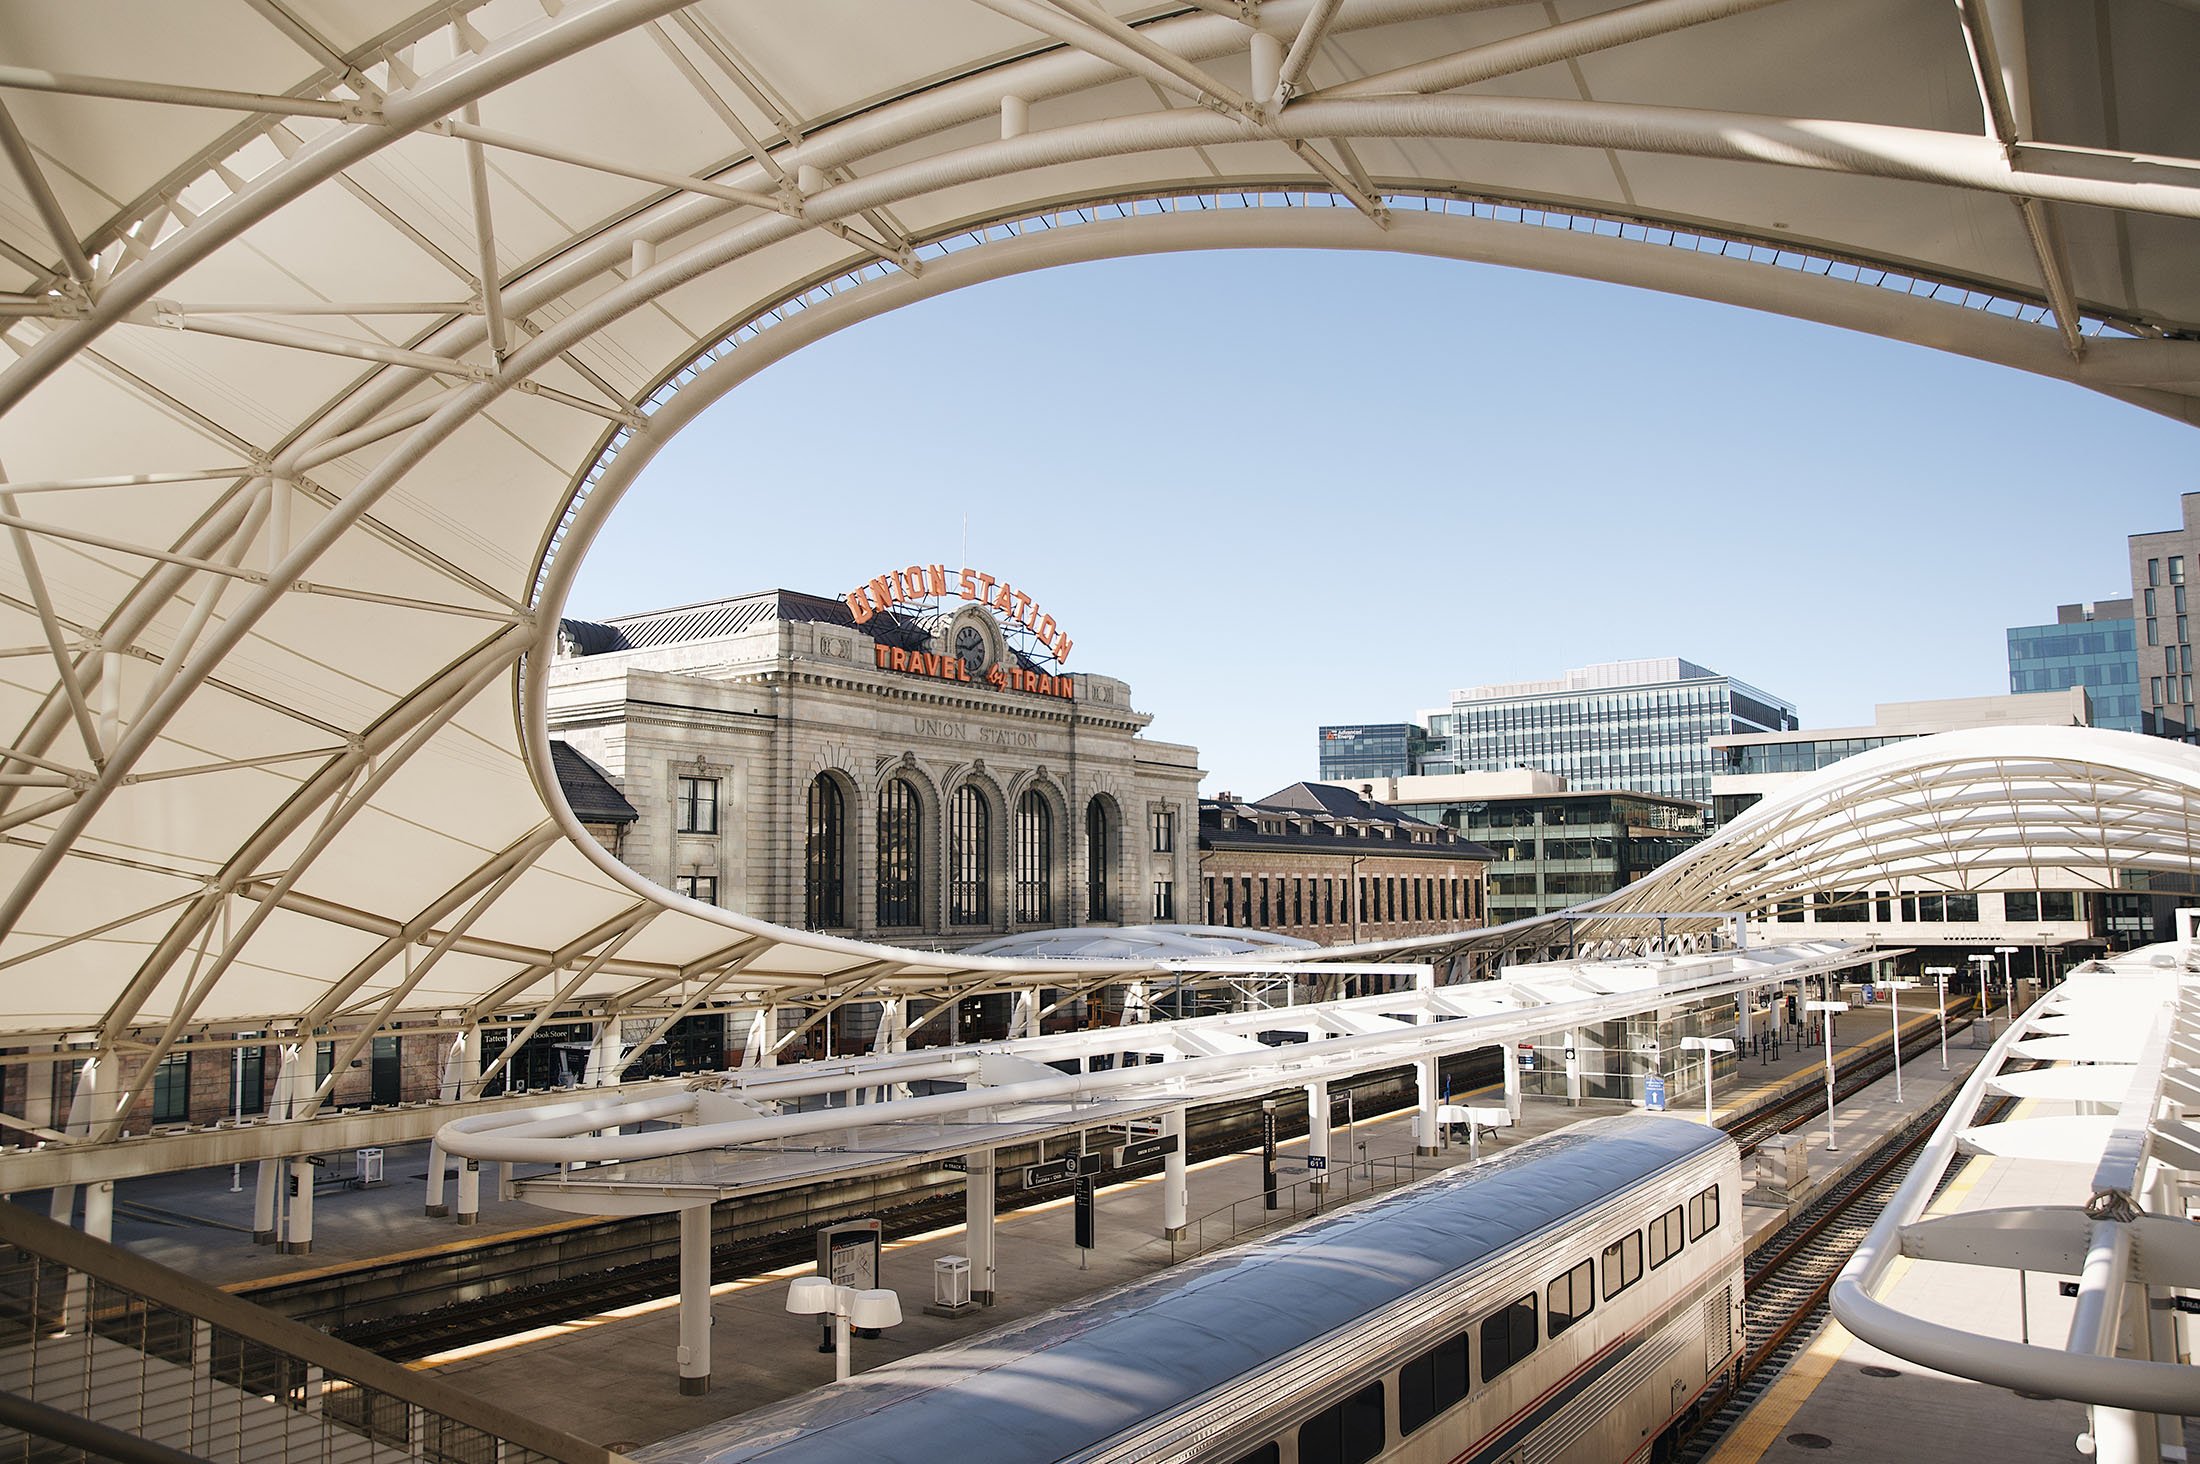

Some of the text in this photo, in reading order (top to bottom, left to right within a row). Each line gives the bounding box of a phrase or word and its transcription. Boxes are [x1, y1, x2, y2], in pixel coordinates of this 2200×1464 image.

[847, 565, 1073, 665] UNION STATION
[875, 644, 1074, 699] TRAVEL by TRAIN
[914, 718, 1038, 748] UNION STATION
[2180, 1300, 2200, 1308] TRA
